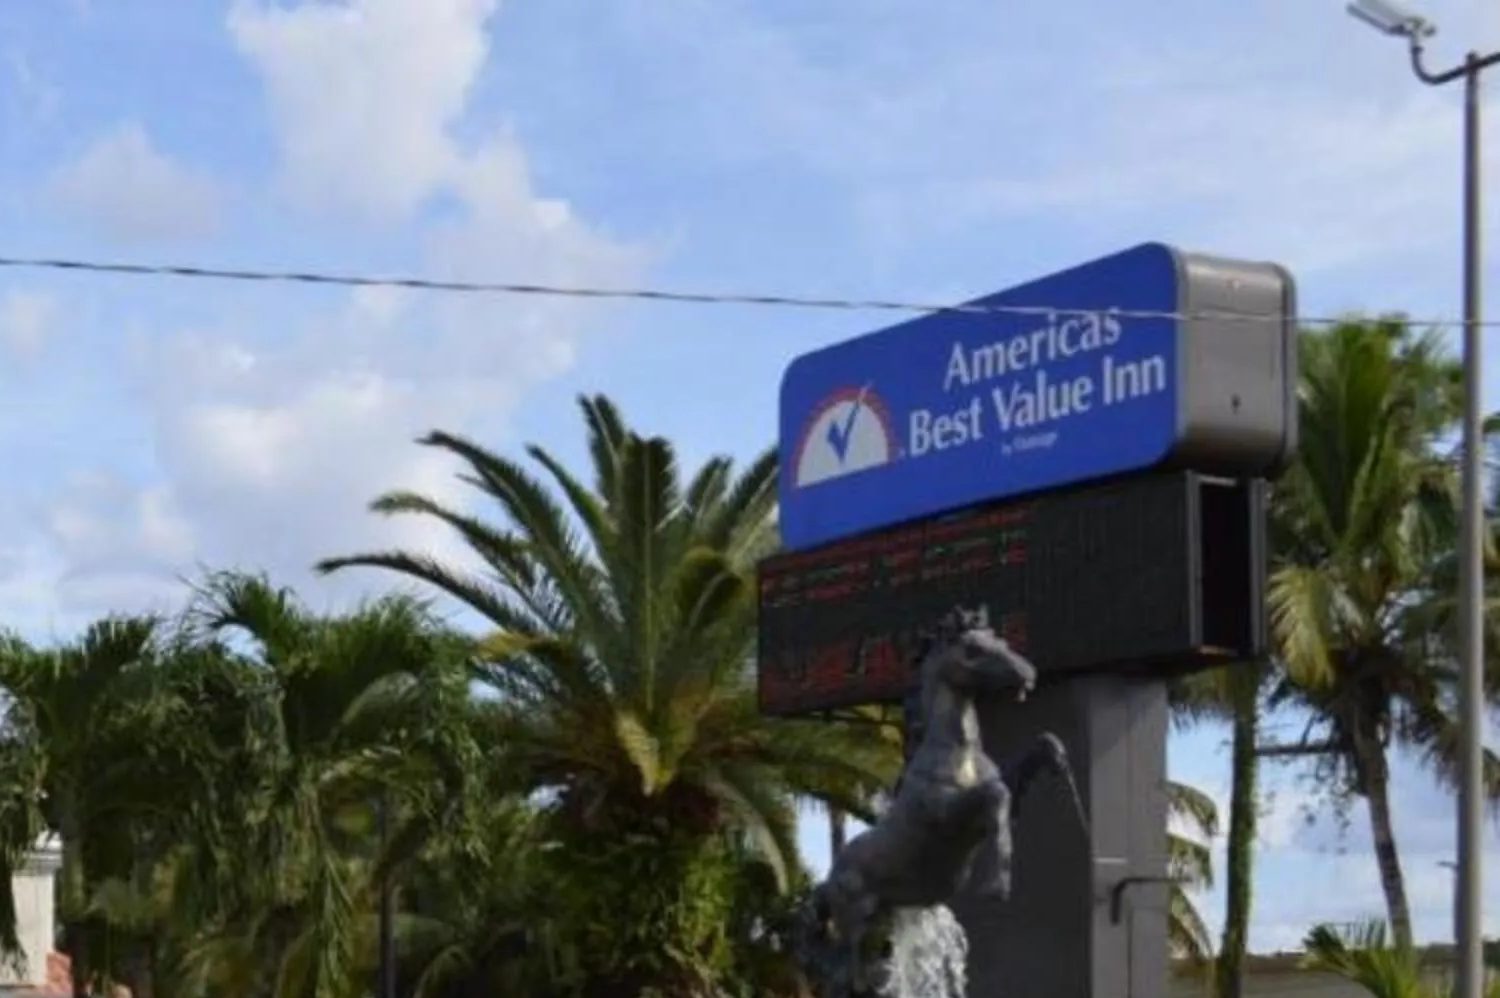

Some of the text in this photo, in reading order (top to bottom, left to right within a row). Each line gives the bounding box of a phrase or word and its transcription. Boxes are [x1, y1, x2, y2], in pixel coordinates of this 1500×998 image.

[943, 307, 1122, 392] Americas
[908, 354, 1167, 458] Best Value Inn
